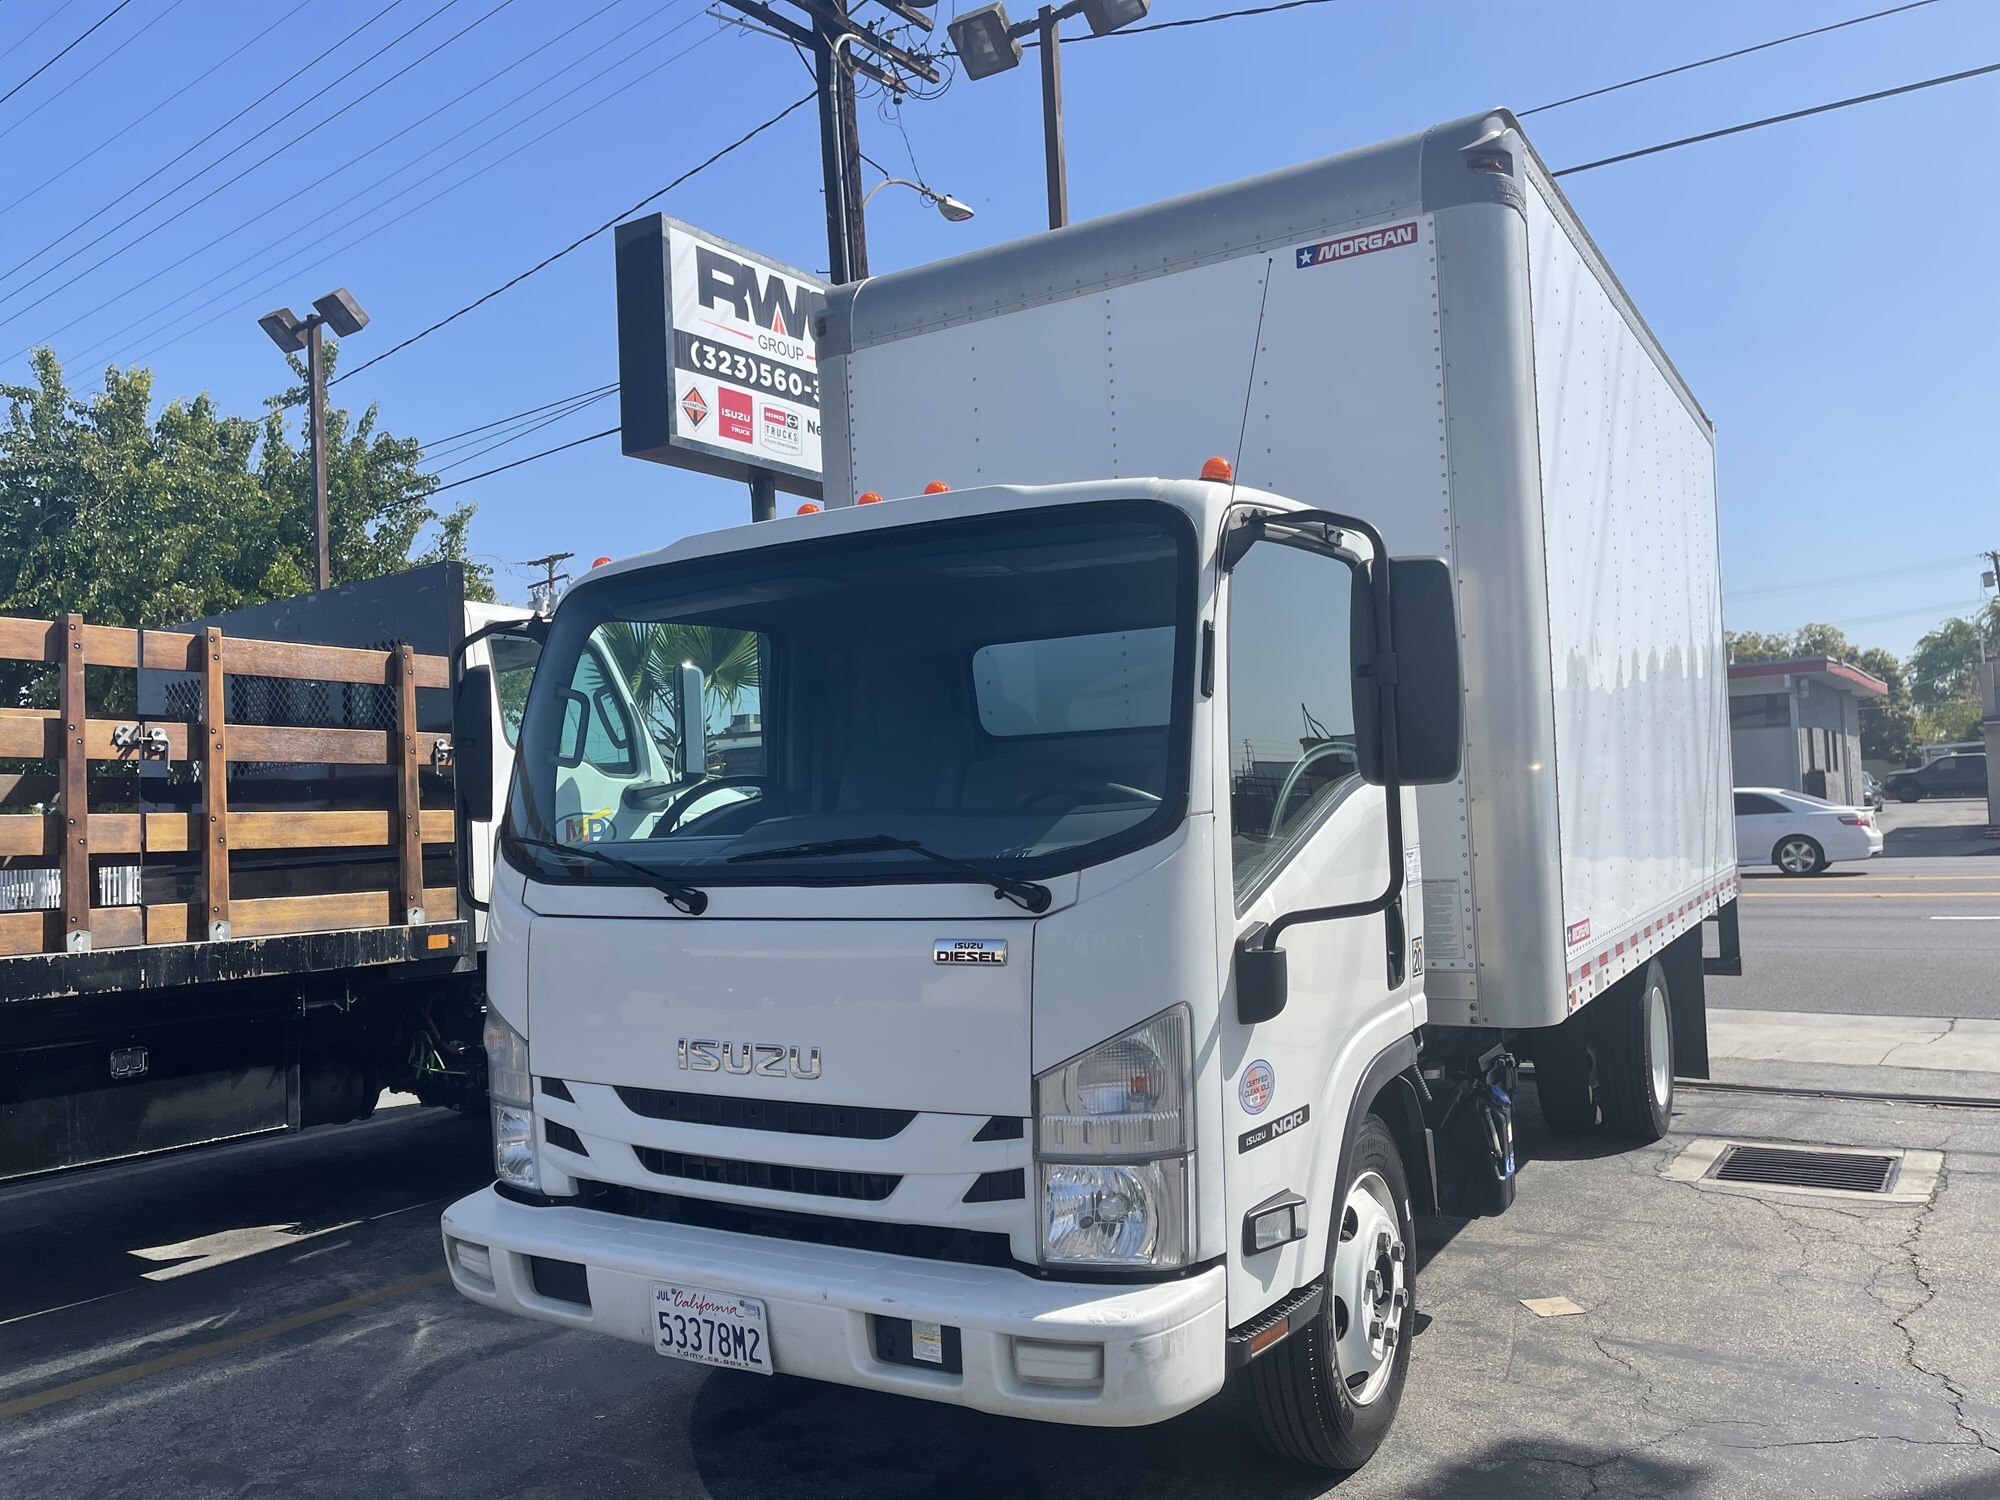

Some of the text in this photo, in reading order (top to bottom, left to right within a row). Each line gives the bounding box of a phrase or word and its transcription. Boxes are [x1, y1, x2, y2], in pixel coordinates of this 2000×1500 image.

[1318, 226, 1412, 261] MORGAN
[757, 334, 804, 361] GROUP
[721, 407, 751, 423] ISUZU
[765, 411, 785, 422] HINO
[731, 426, 750, 437] TRUCK
[766, 425, 798, 442] TRUCKS
[954, 942, 984, 950] ISUZU
[936, 951, 1002, 963] DIESEL
[677, 1038, 822, 1080] ISUZU
[1246, 1074, 1269, 1088] CERTIFIED
[1245, 1087, 1260, 1098] CLEAN
[1261, 1082, 1270, 1092] IDLE
[1245, 1110, 1304, 1147] ISUZU NQR
[656, 1290, 670, 1301] JUL
[673, 1290, 745, 1318] California
[658, 1311, 763, 1365] 53378M2
[683, 1350, 742, 1367] dmv.ca.gov
